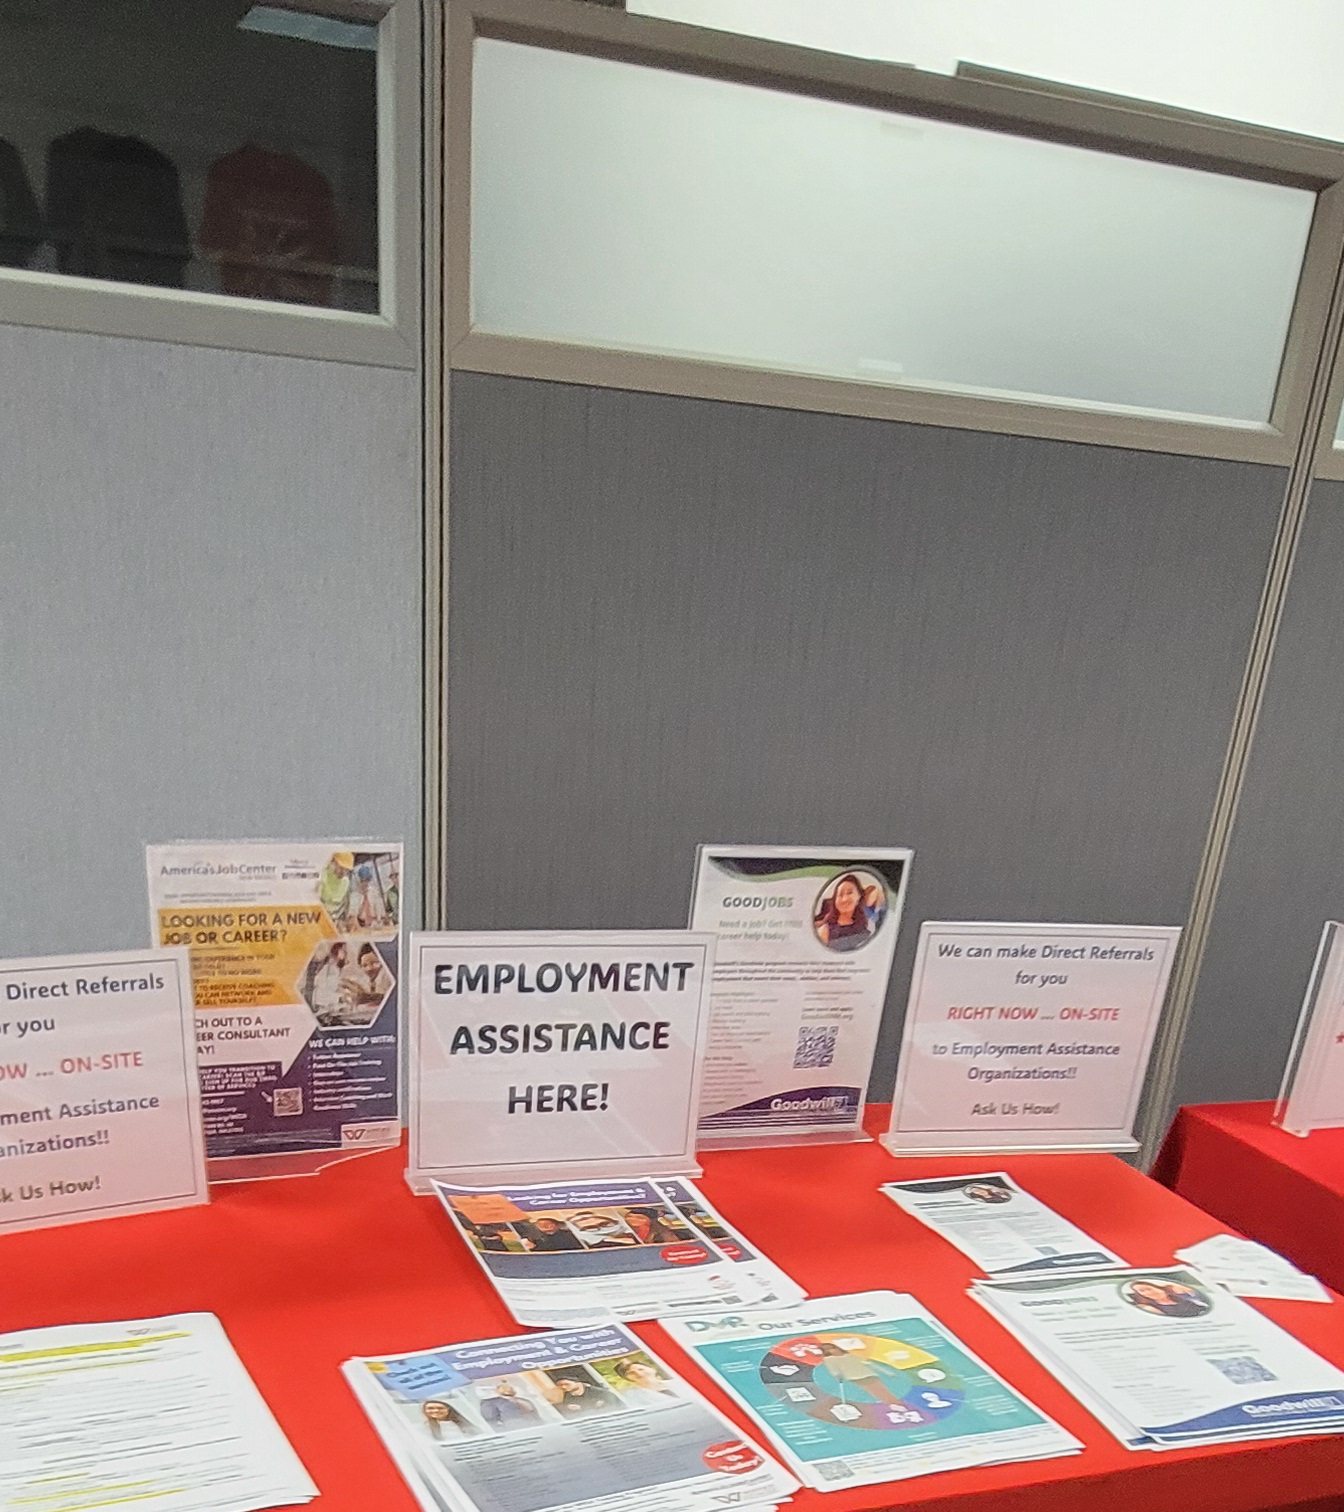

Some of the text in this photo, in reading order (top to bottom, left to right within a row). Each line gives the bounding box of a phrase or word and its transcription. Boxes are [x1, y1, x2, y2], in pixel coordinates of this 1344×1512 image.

[160, 911, 322, 928] LOOKING FOR A NEW
[162, 929, 288, 946] JOB OR CAREER?
[937, 944, 1155, 962] We can make Direct Referrals
[6, 980, 70, 1001] Direct
[75, 973, 165, 996] Referrals
[434, 961, 695, 995] EMPLOYMENT
[1014, 970, 1068, 988] for you
[211, 1017, 234, 1028] OUT
[236, 1016, 253, 1027] TO
[254, 1015, 263, 1026] A
[947, 1006, 994, 1021] RIGHT
[997, 1006, 1039, 1021] NOW
[1059, 1007, 1120, 1021] ON-SITE
[16, 1017, 56, 1038] you
[196, 1027, 291, 1042] EER CONSULTANT
[450, 1021, 671, 1055] ASSISTANCE
[197, 1044, 215, 1055] AY!
[932, 1042, 1120, 1058] to Employment Assistance
[59, 1051, 144, 1075] ON-SITE
[967, 1066, 1078, 1083] Organizations!!
[58, 1094, 160, 1119] Assistance
[507, 1082, 610, 1114] HERE!
[971, 1102, 1060, 1116] Ask Us How!
[19, 1184, 44, 1202] Us
[49, 1175, 102, 1197] How!
[757, 1321, 794, 1331] Our
[796, 1310, 877, 1328] Services
